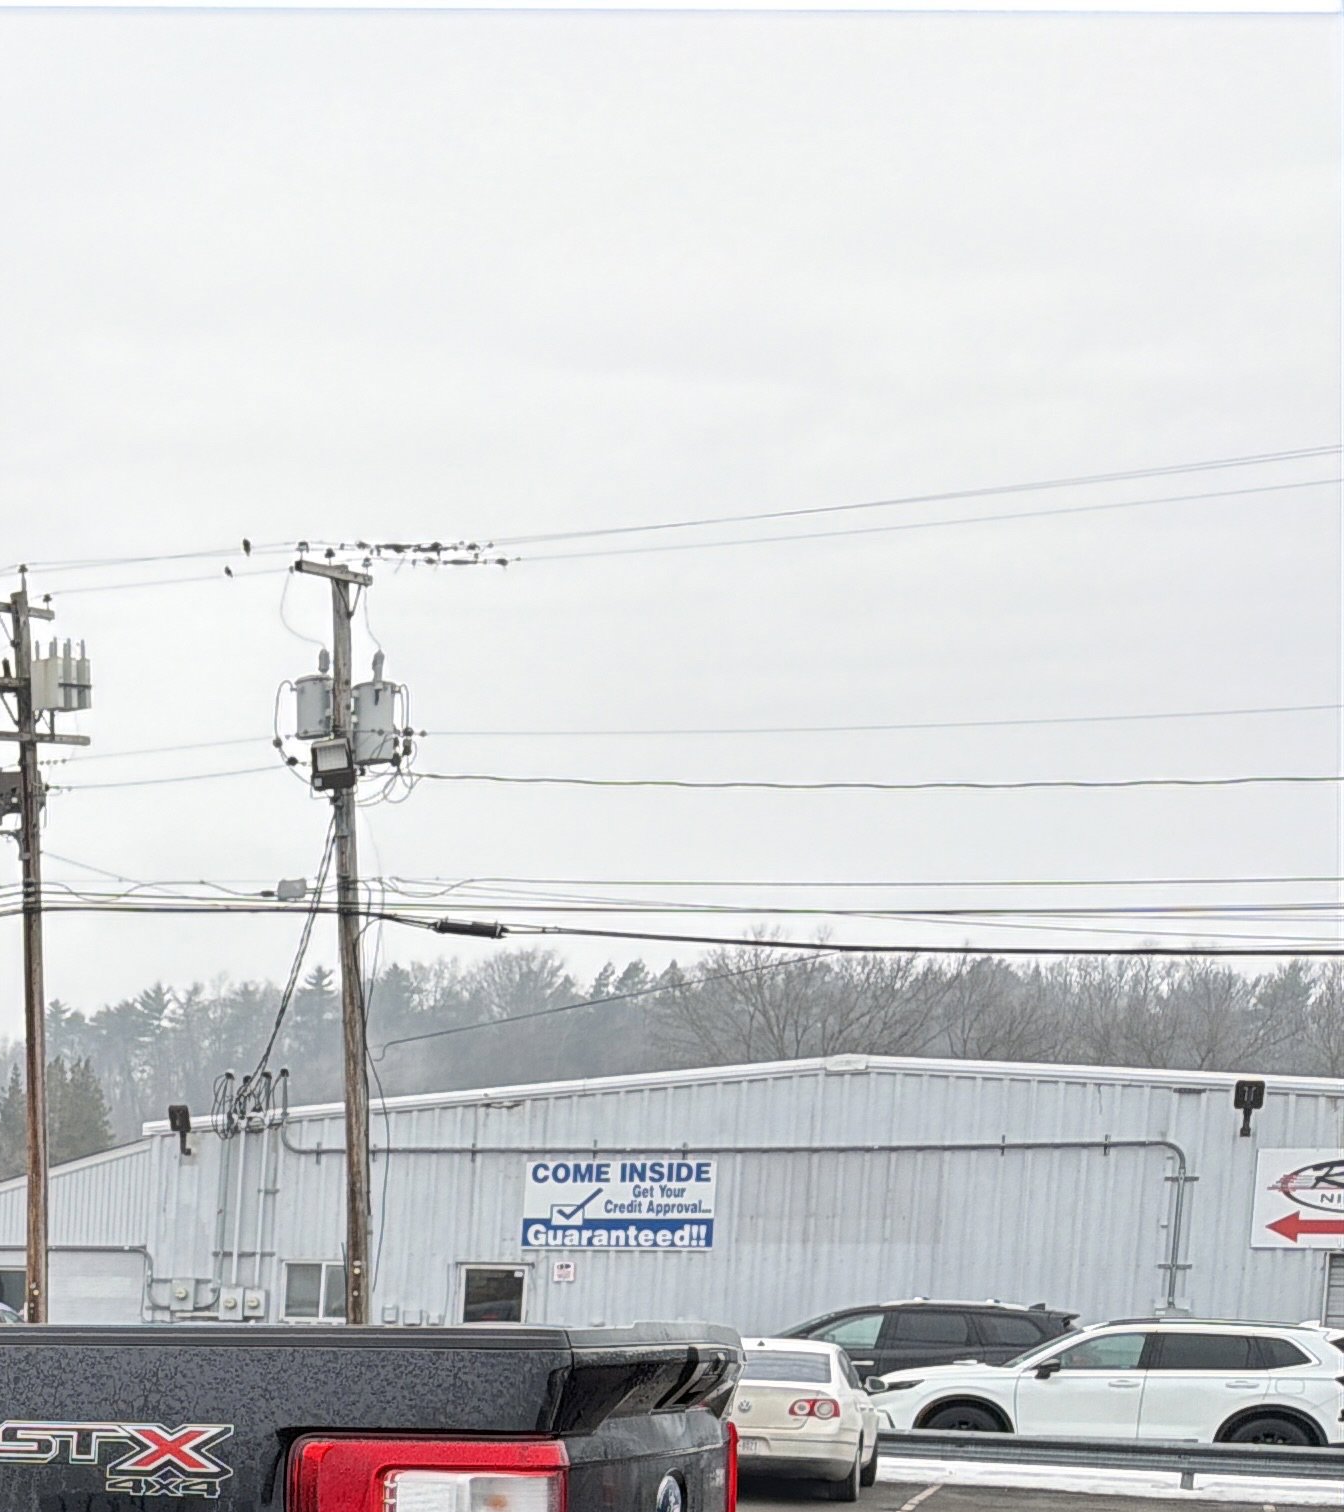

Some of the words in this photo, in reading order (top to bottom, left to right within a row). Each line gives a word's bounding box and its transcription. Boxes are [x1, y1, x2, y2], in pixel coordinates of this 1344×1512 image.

[531, 1162, 611, 1184] COME
[619, 1162, 712, 1184] INSIDE
[632, 1184, 654, 1199] Get
[658, 1184, 687, 1199] Your
[604, 1200, 643, 1214] Credit
[526, 1223, 708, 1246] Guaranteed!!
